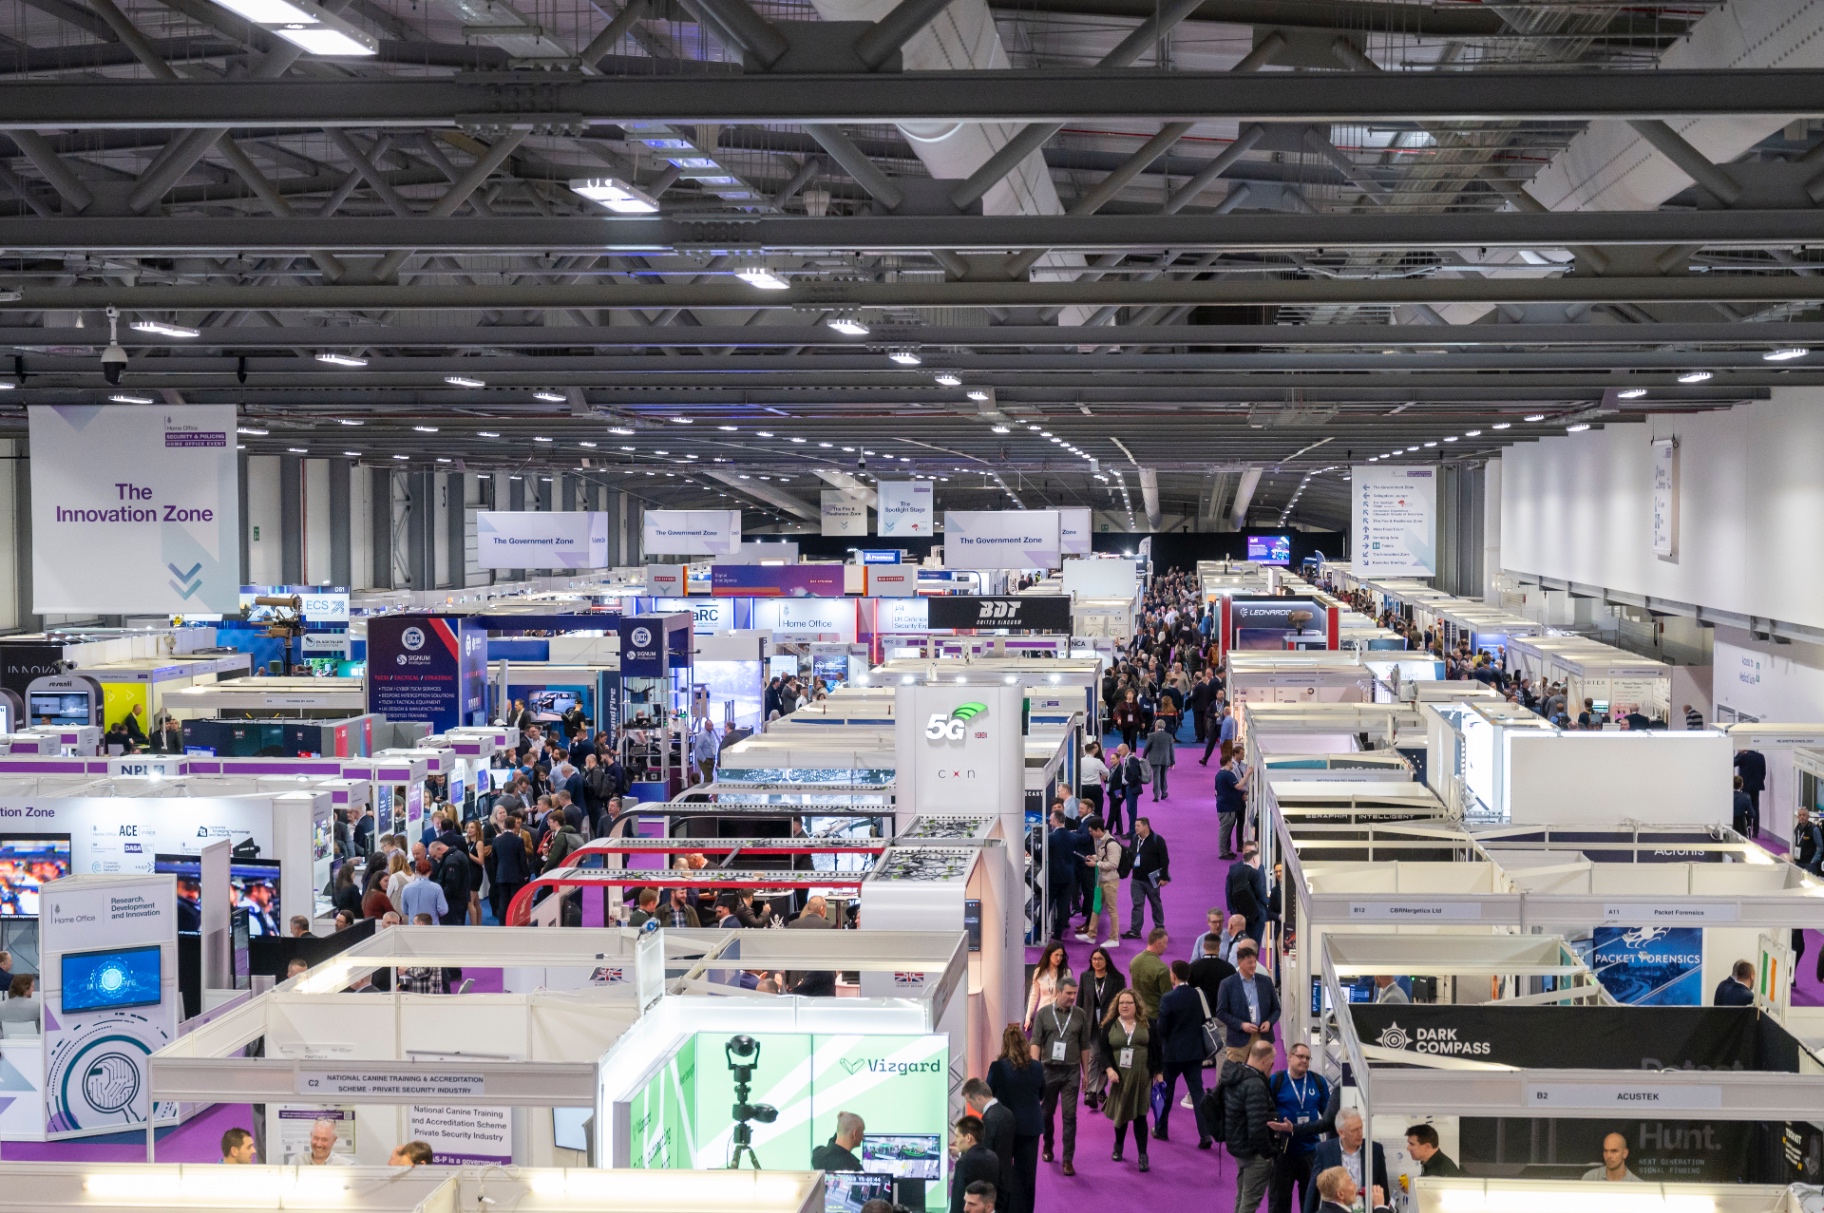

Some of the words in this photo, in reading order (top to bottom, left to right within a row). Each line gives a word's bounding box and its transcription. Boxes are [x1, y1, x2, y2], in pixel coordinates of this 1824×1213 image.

[115, 483, 152, 500] The
[56, 506, 157, 522] Innovation
[163, 506, 214, 522] Zone
[306, 600, 329, 610] ECS
[979, 601, 1022, 618] BDT
[783, 620, 805, 628] Home
[808, 619, 832, 628] Office
[925, 713, 965, 740] 5G
[121, 765, 150, 775] NPL
[0, 807, 22, 818] tion
[25, 807, 55, 818] Zone
[119, 825, 137, 836] ACE
[111, 896, 145, 904] Research,
[111, 902, 155, 912] Development
[126, 910, 160, 918] Innovation
[54, 916, 74, 924] Home
[1595, 954, 1635, 964] PACKET
[1416, 1028, 1458, 1040] DARK
[1416, 1041, 1490, 1054] COMPASS
[868, 1059, 941, 1076] Vizgard
[414, 1106, 444, 1115] National
[446, 1108, 472, 1116] Canine
[473, 1109, 504, 1119] Training
[426, 1118, 475, 1128] Accreditation
[477, 1120, 507, 1129] Scheme
[414, 1129, 439, 1137] Private
[442, 1130, 472, 1140] Security
[473, 1132, 503, 1142] Industry
[1639, 1123, 1722, 1150] Hunt.
